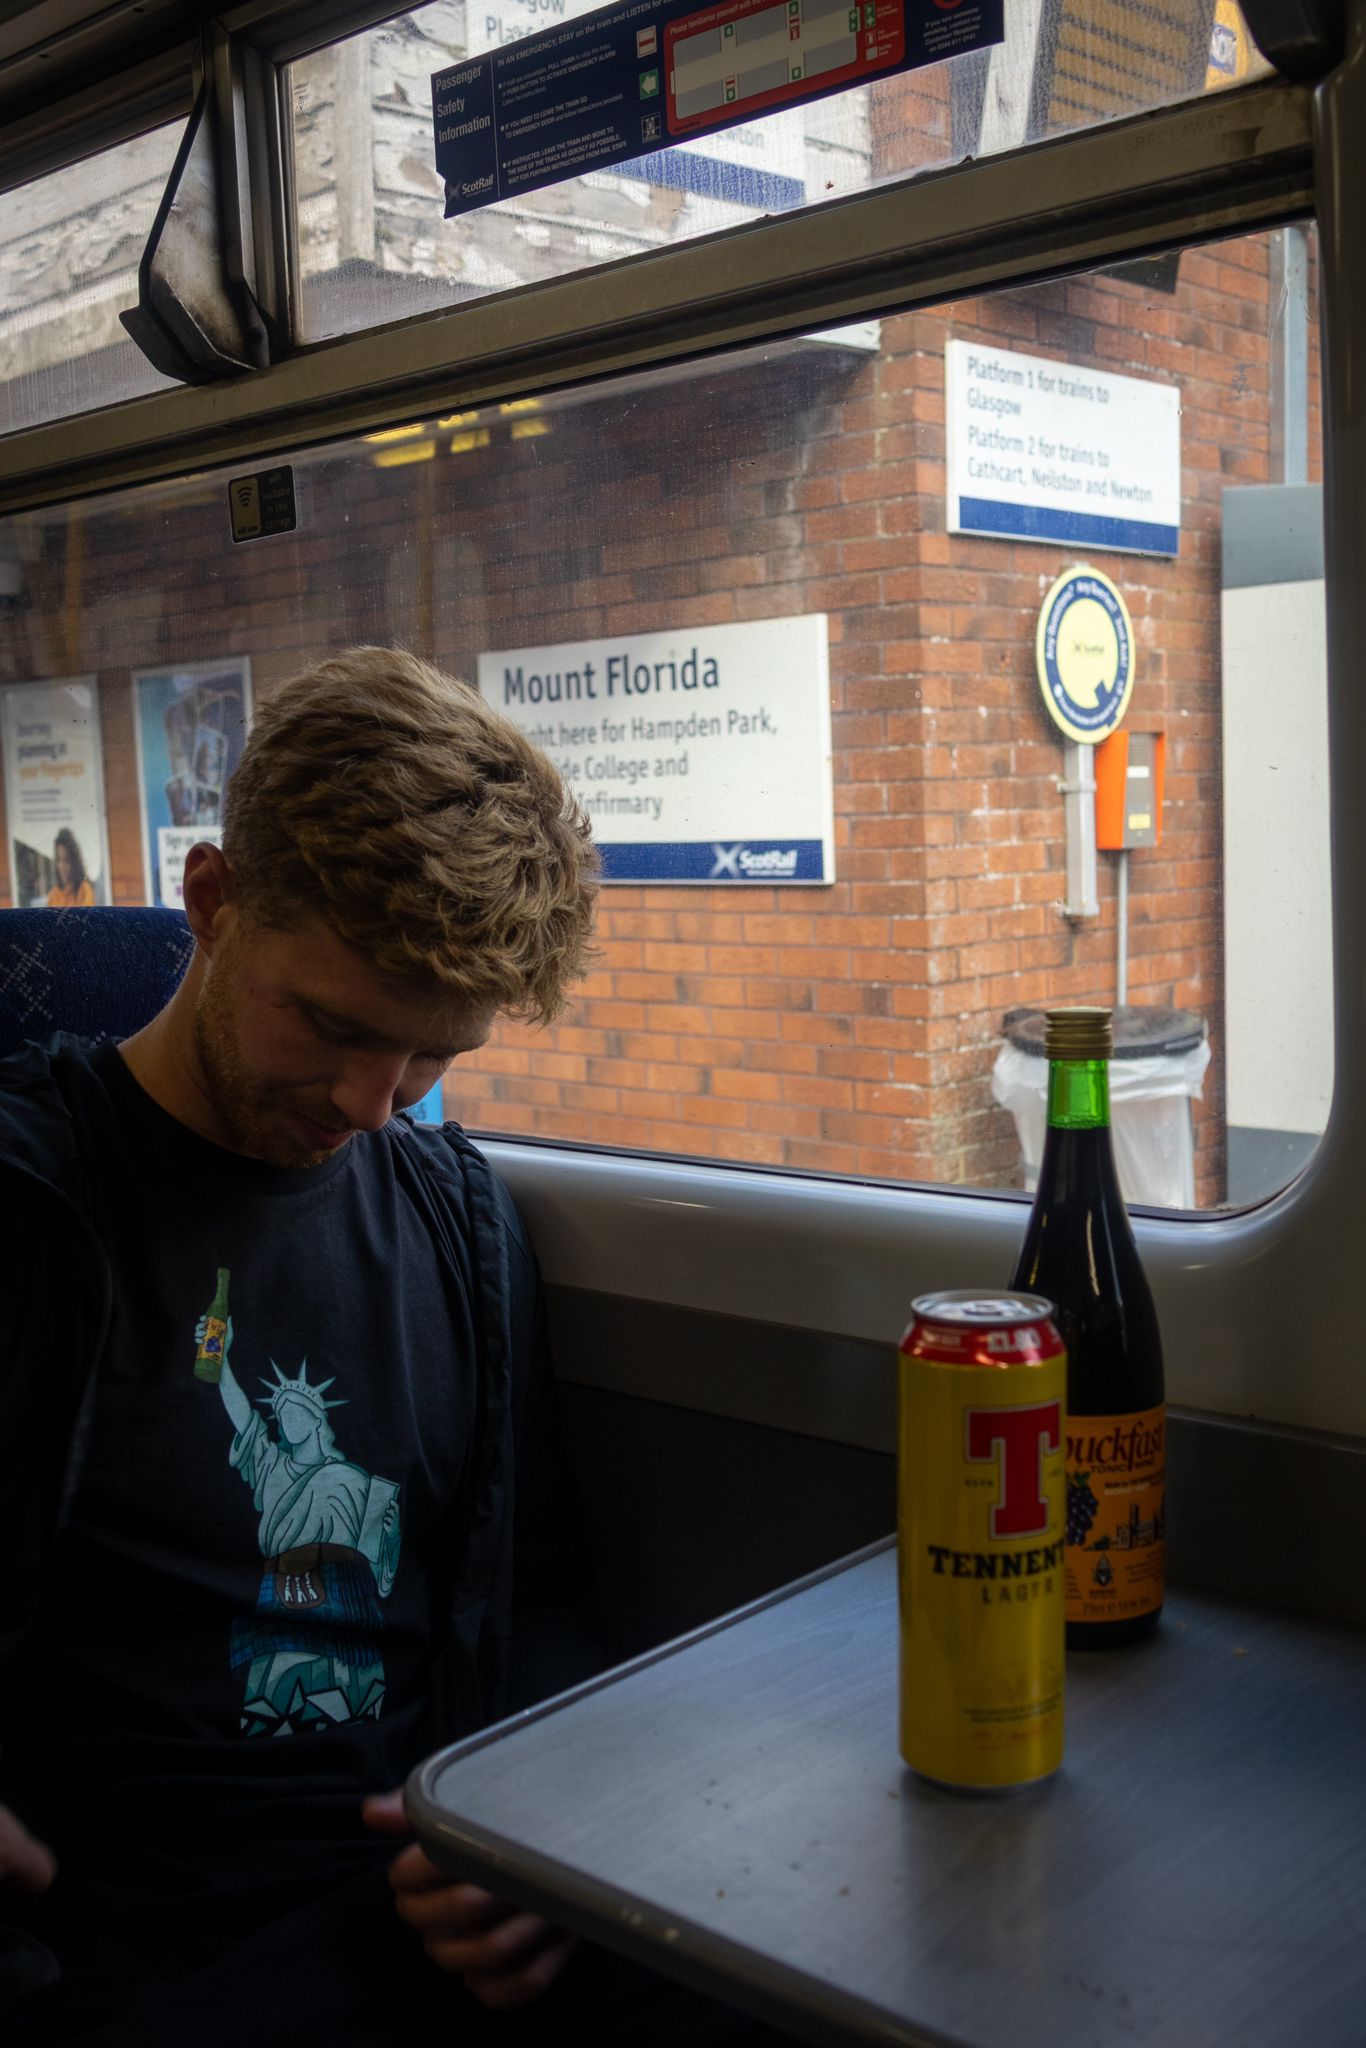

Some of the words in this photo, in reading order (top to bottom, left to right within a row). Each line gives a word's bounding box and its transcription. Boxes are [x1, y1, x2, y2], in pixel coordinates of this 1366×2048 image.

[506, 54, 515, 65] AN
[516, 39, 558, 60] EMERGENCY,
[559, 31, 575, 44] STAY
[576, 30, 585, 38] on
[585, 24, 596, 34] the
[597, 19, 612, 30] train
[613, 13, 625, 24] and
[626, 2, 651, 18] LISTEN
[670, 24, 687, 35] Please
[436, 65, 482, 93] Passenger
[520, 79, 538, 90] BUTTON
[568, 58, 598, 73] EMERGENCY
[437, 97, 465, 118] Safety
[510, 120, 520, 128] YOU
[520, 116, 533, 125] NEED
[533, 113, 540, 121] TO
[540, 108, 554, 119] LEAVE
[555, 104, 565, 112] THE
[565, 99, 580, 110] TRAIN
[580, 96, 588, 104] GO
[439, 115, 491, 144] Information
[513, 121, 541, 137] EMERGENCY
[541, 117, 555, 127] DOOR
[542, 146, 556, 156] LEAVE
[557, 143, 566, 151] THE
[566, 137, 581, 147] TRAIN
[581, 134, 591, 142] AND
[592, 129, 607, 139] MOVE
[607, 126, 614, 134] TO
[508, 168, 517, 176] THE
[517, 164, 527, 173] SIDE
[535, 159, 545, 167] THE
[545, 154, 561, 164] TRACK
[561, 151, 568, 159] AS
[568, 145, 588, 157] QUICKLY
[508, 176, 519, 185] WAIT
[520, 172, 530, 181] FOR
[530, 165, 551, 178] FURTHER
[551, 155, 586, 171] INSTRUCTIONS
[586, 150, 600, 159] FROM
[600, 146, 612, 155] RAIL
[462, 174, 494, 195] ScotRail
[968, 356, 1024, 386] Platform
[1028, 370, 1034, 389] 1
[1038, 370, 1055, 391] for
[1059, 377, 1094, 401] trains
[1097, 386, 1110, 404] to
[968, 387, 1021, 418] Glasgow
[968, 424, 1024, 453] Platform
[1028, 436, 1035, 456] 2
[1039, 435, 1055, 458] for
[1059, 443, 1094, 465] trains
[1097, 451, 1110, 468] to
[968, 456, 1027, 485] Cathcart,
[1032, 467, 1082, 491] Neilston
[1087, 477, 1107, 497] and
[1110, 479, 1152, 504] Newton
[504, 661, 597, 705] Mount
[607, 647, 719, 697] Florida
[559, 722, 598, 746] here
[601, 718, 626, 742] for
[632, 712, 721, 745] Hampden
[727, 707, 777, 735] Park,
[585, 755, 649, 785] College
[654, 751, 689, 776] and
[739, 850, 798, 869] ScotRail
[964, 1397, 1063, 1540] T
[982, 1577, 1054, 1604] LAGER
